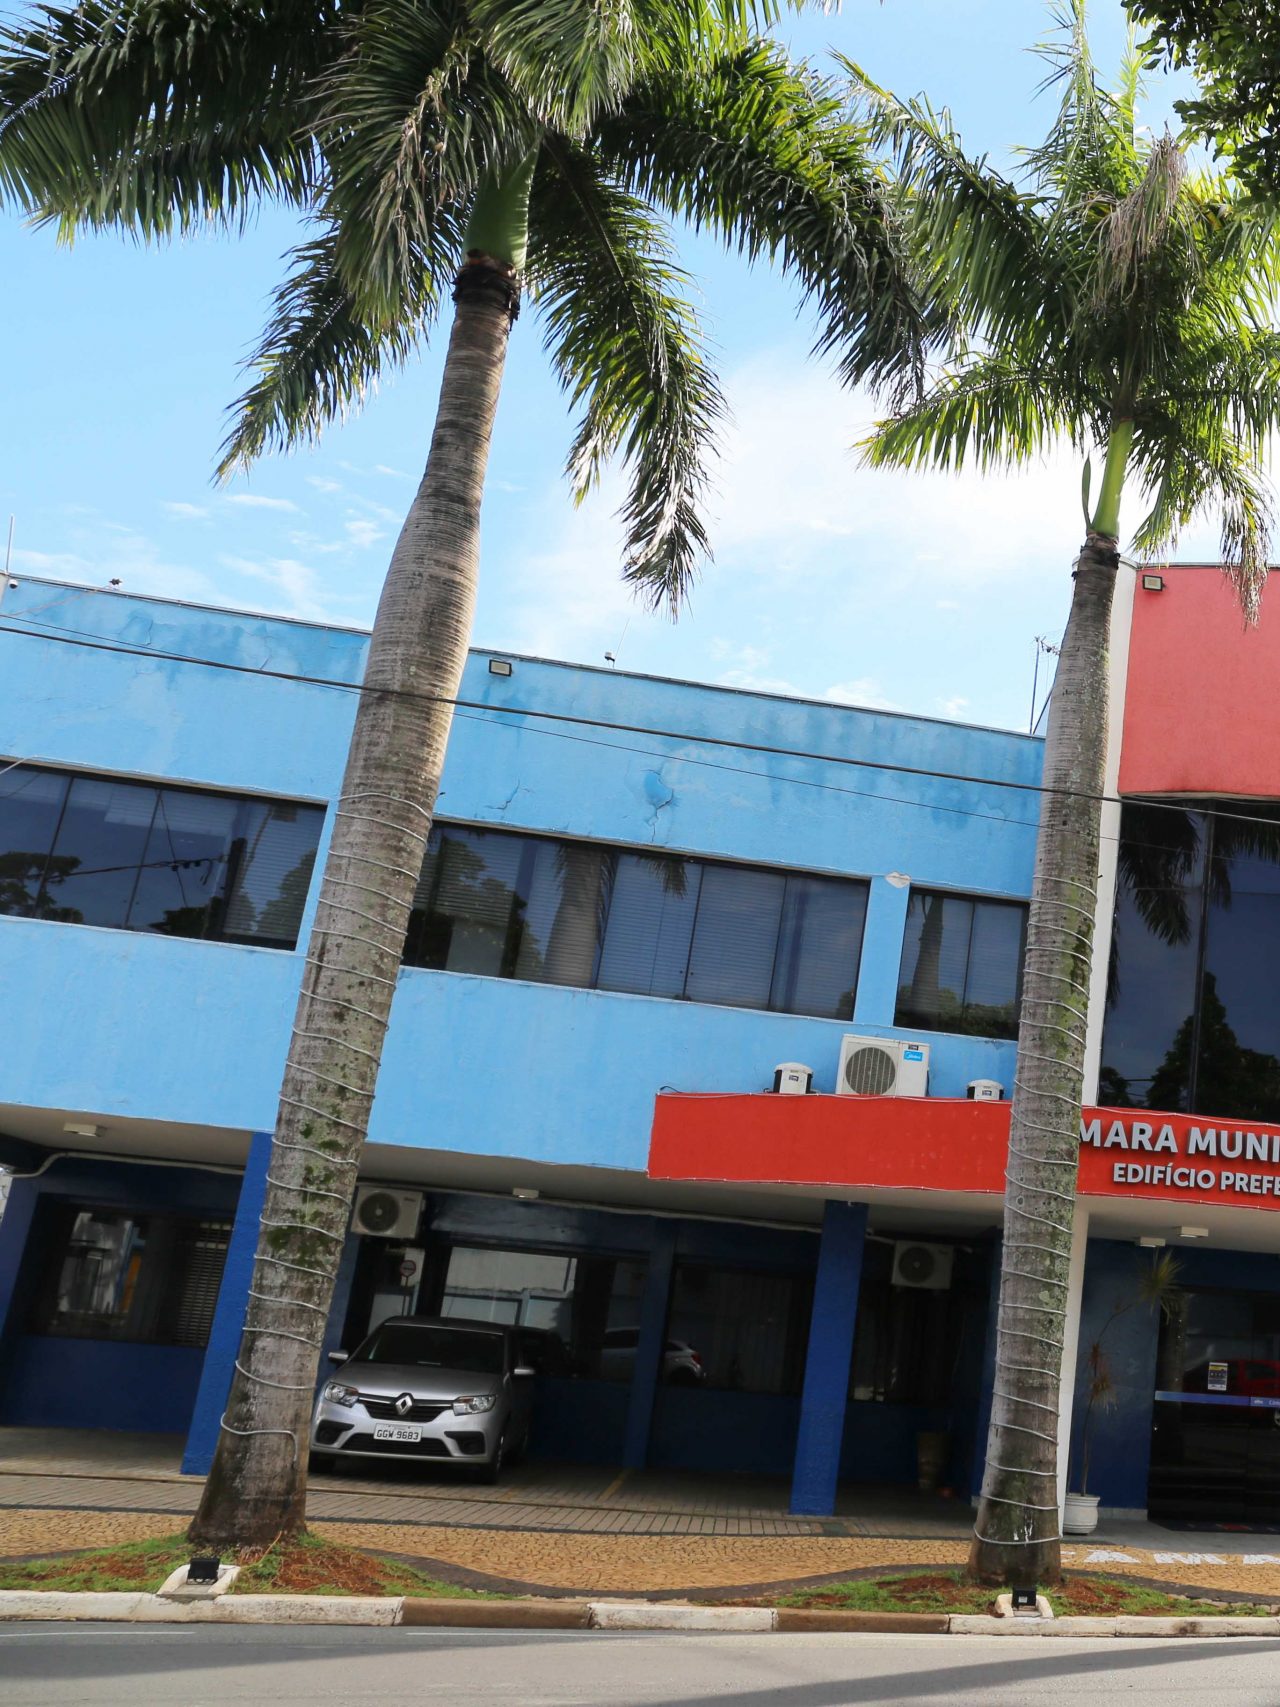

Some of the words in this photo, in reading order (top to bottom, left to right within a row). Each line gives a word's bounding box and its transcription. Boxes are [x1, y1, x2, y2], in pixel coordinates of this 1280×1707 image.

[1079, 1119, 1178, 1153] MARA
[1113, 1162, 1216, 1189] EDIFÍCIO
[376, 1429, 394, 1439] GGW
[396, 1430, 419, 1440] 9683
